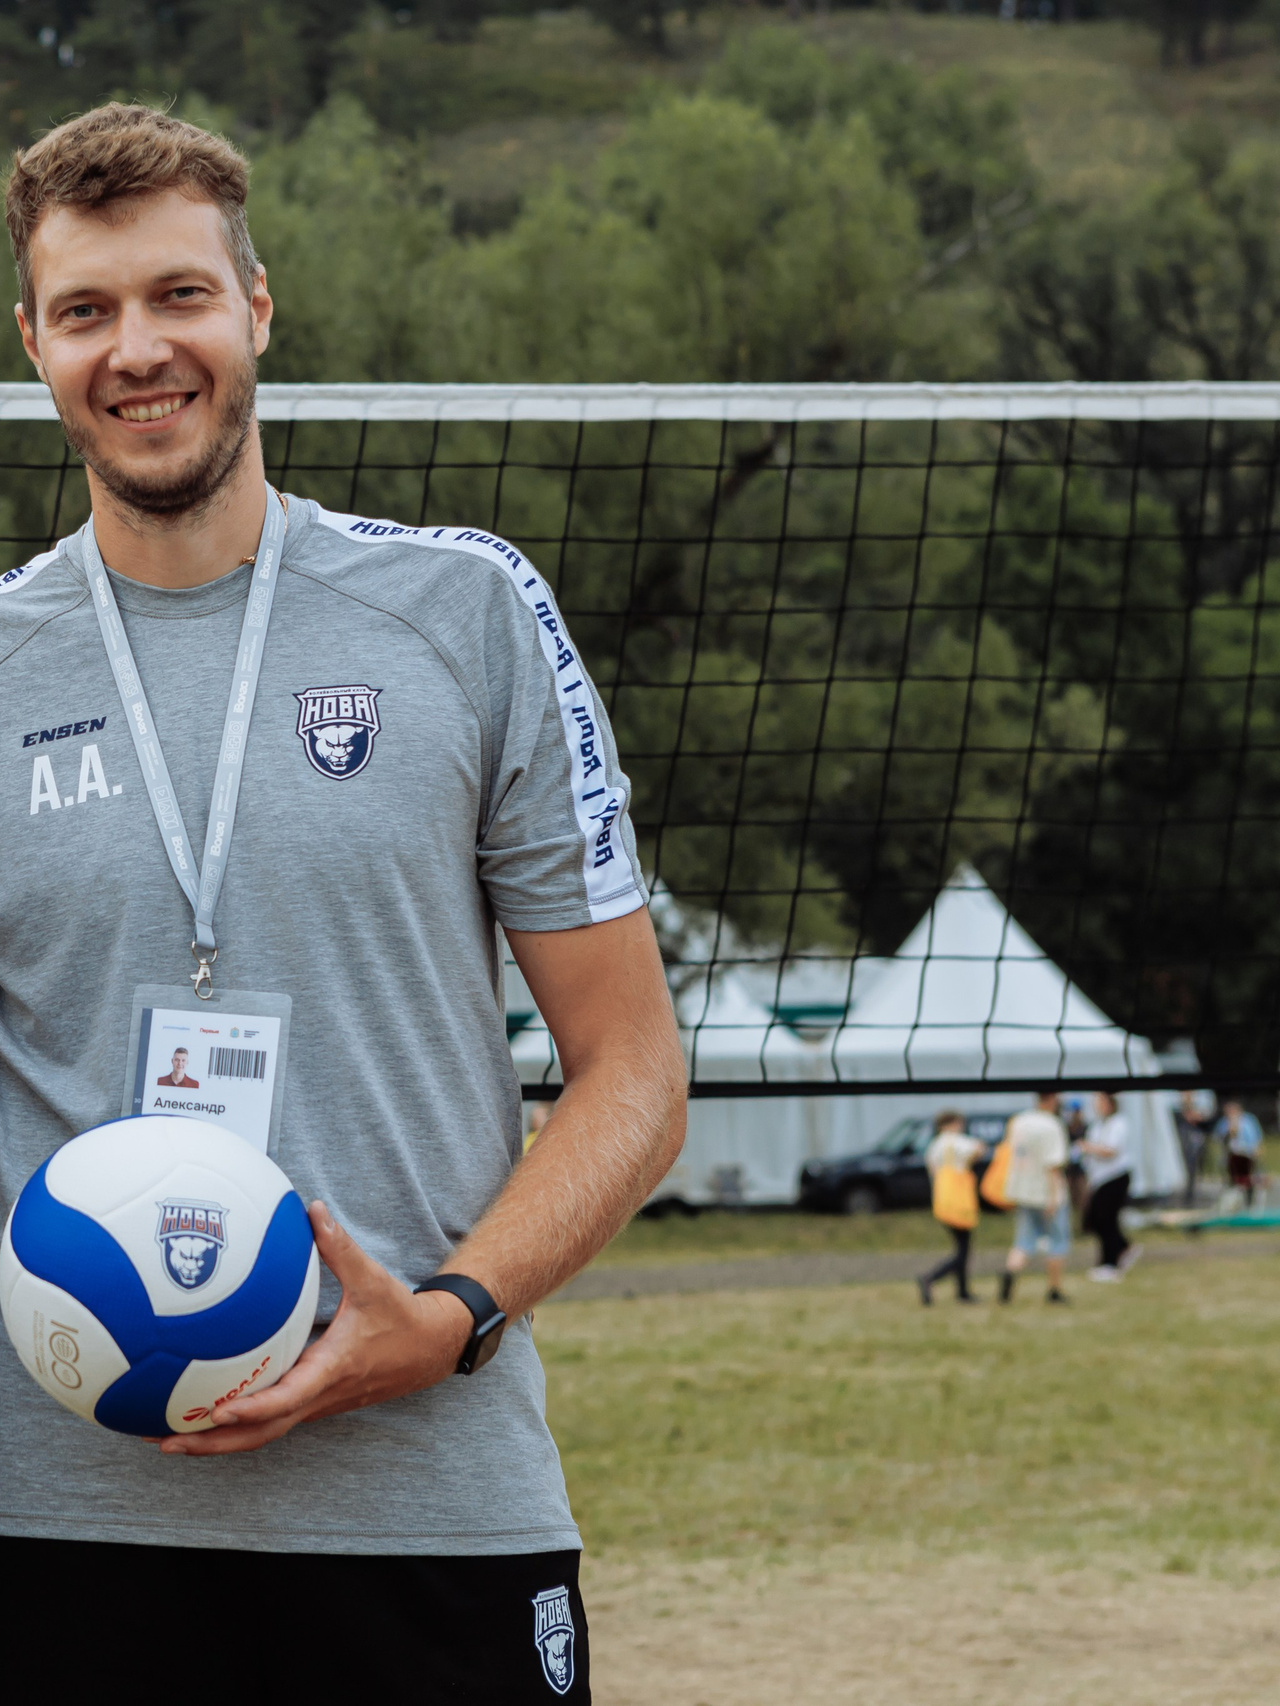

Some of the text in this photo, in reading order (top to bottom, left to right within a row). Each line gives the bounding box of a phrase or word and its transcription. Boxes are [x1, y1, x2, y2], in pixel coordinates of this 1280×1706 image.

[454, 530, 522, 570] НОВА
[304, 695, 373, 726] НОВА
[22, 716, 107, 748] ENSEN
[154, 1097, 226, 1115] Александр
[163, 1207, 221, 1238] НОВА
[538, 1596, 572, 1636] НОВА
